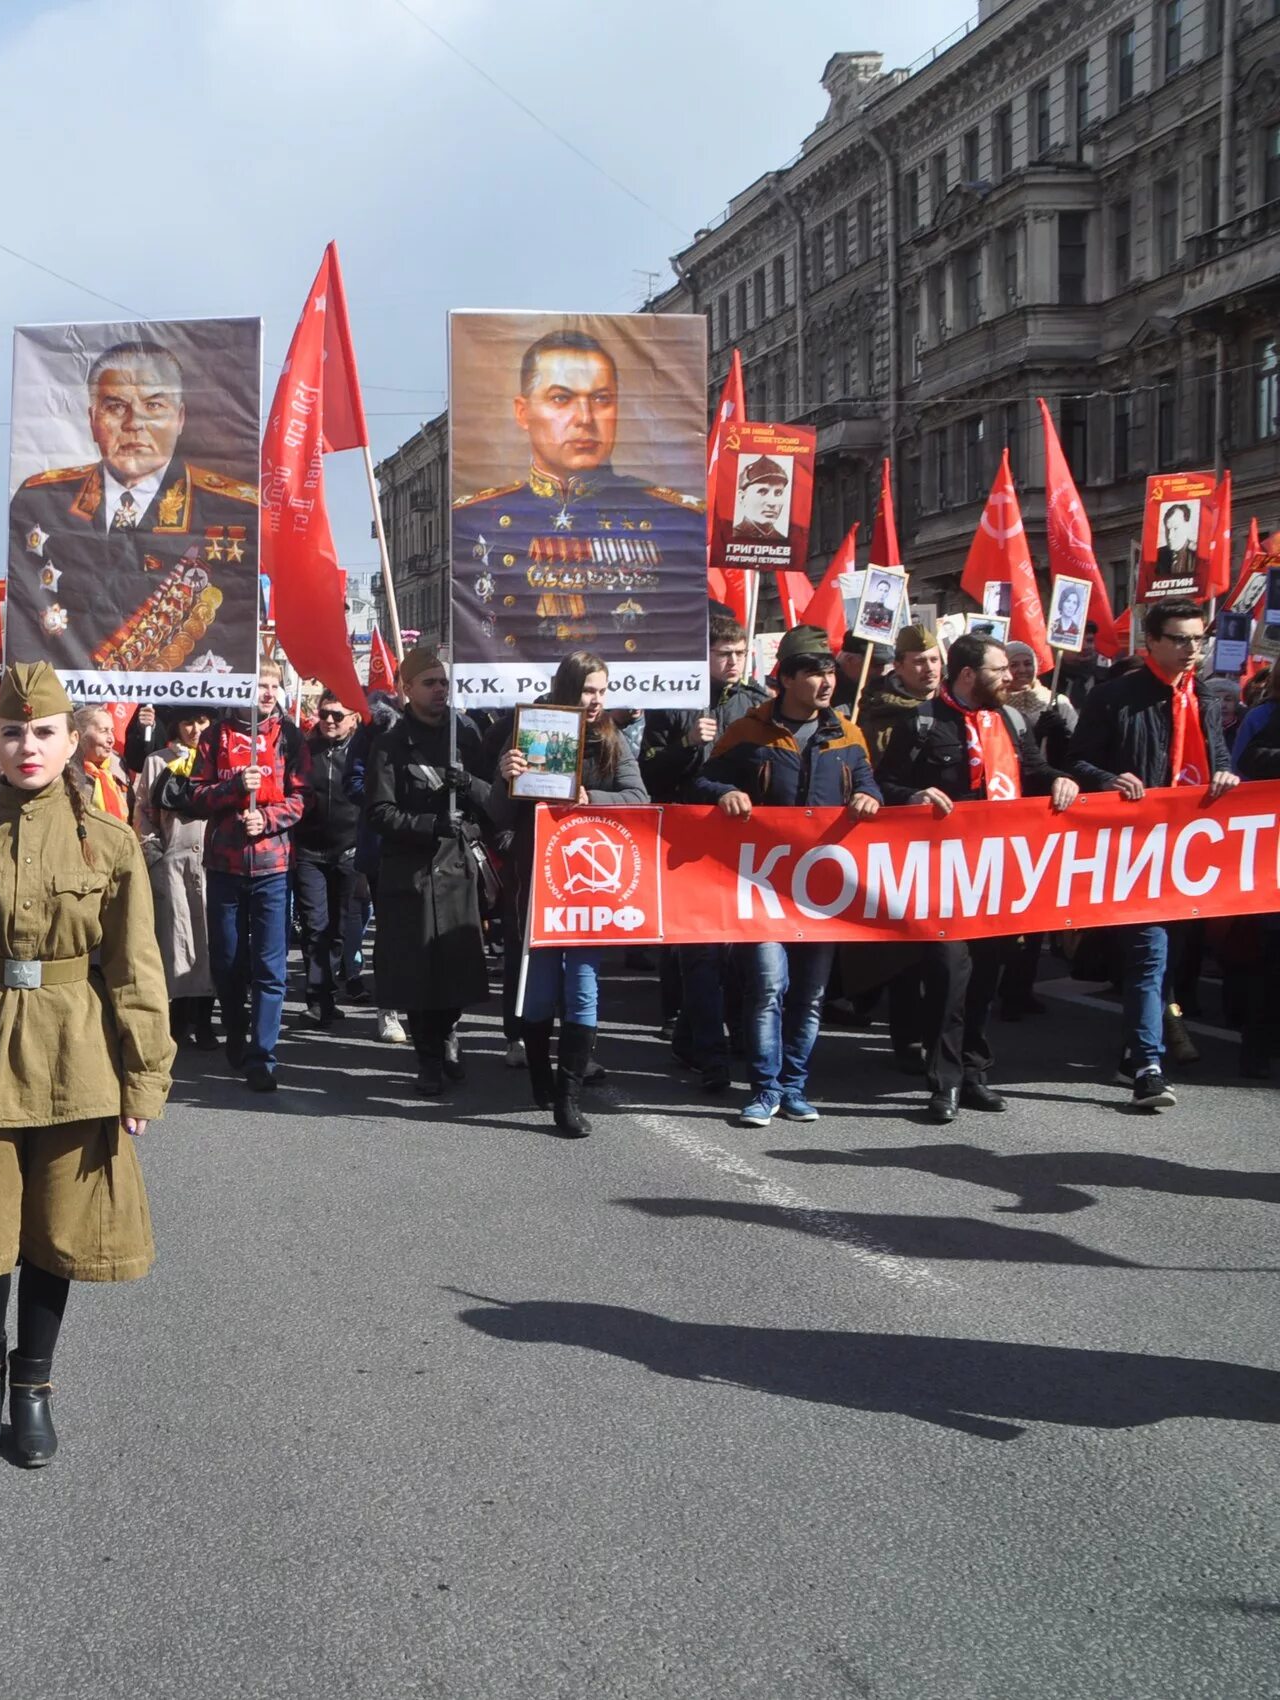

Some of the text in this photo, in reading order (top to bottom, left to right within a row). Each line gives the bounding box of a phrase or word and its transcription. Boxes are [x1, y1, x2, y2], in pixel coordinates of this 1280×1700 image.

[726, 543, 791, 556] ГРИГОРЬЕВ
[1152, 577, 1194, 590] КОТИН
[64, 679, 252, 699] Малиновский
[456, 673, 702, 694] К.К. Роовский
[545, 836, 559, 858] ТРУД
[560, 815, 632, 841] НАРОДОВЛАСТИЕ
[736, 813, 1280, 920] КОММУНИСТ
[543, 905, 645, 932] КПРФ
